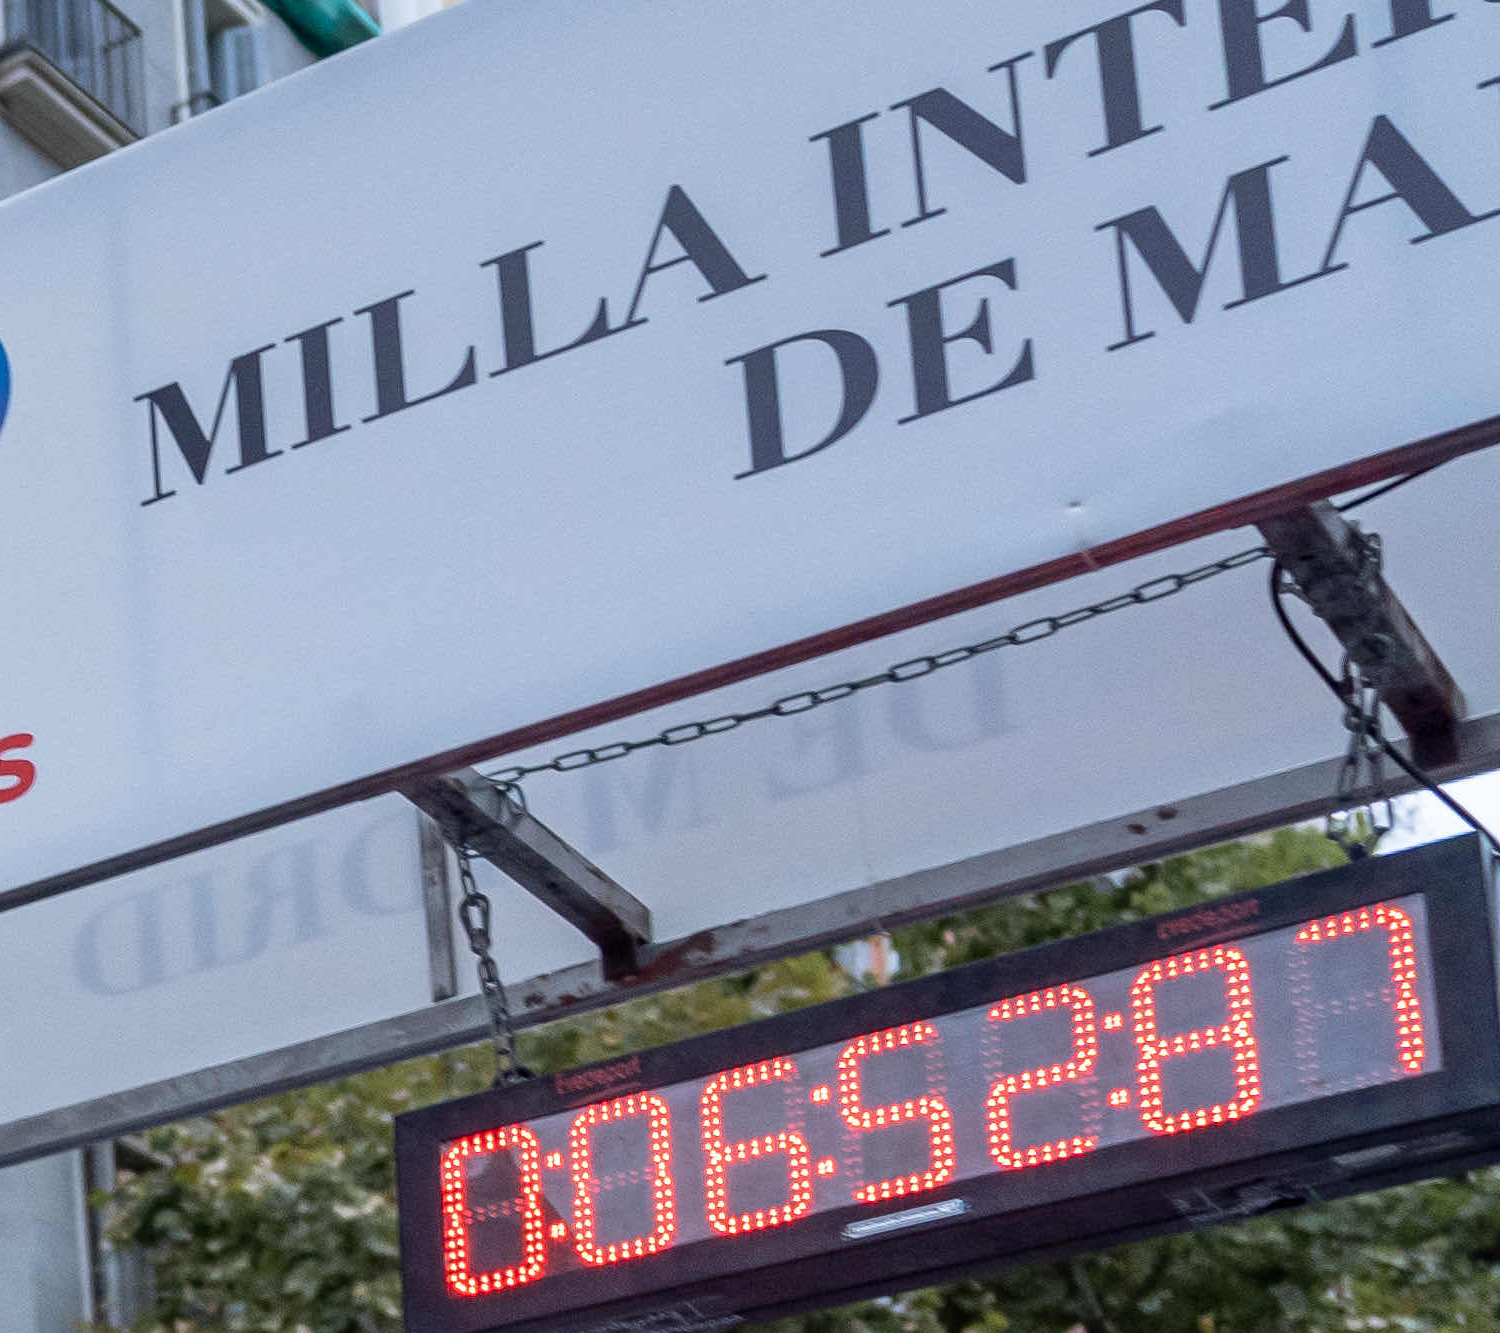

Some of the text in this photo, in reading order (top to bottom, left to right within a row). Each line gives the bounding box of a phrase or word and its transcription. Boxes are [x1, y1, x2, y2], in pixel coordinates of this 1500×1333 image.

[133, 183, 768, 507] MILLA
[723, 76, 1500, 480] DE MA
